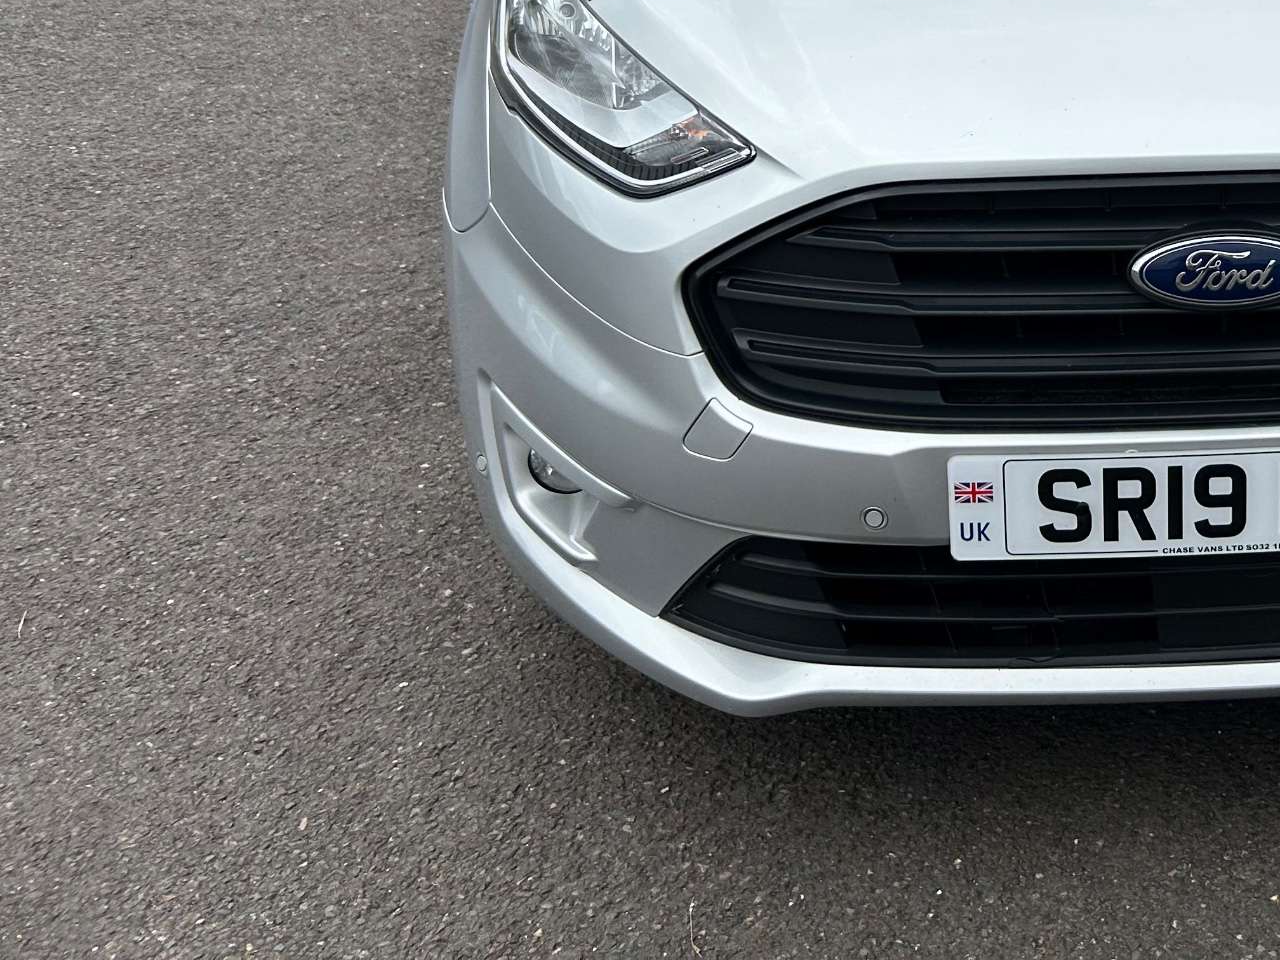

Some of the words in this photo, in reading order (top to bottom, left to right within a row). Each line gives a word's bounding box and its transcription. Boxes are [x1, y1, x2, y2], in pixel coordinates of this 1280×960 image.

[1175, 249, 1277, 292] Ford
[1037, 463, 1248, 544] SR19
[960, 521, 991, 542] UK
[1162, 546, 1195, 554] CHASE
